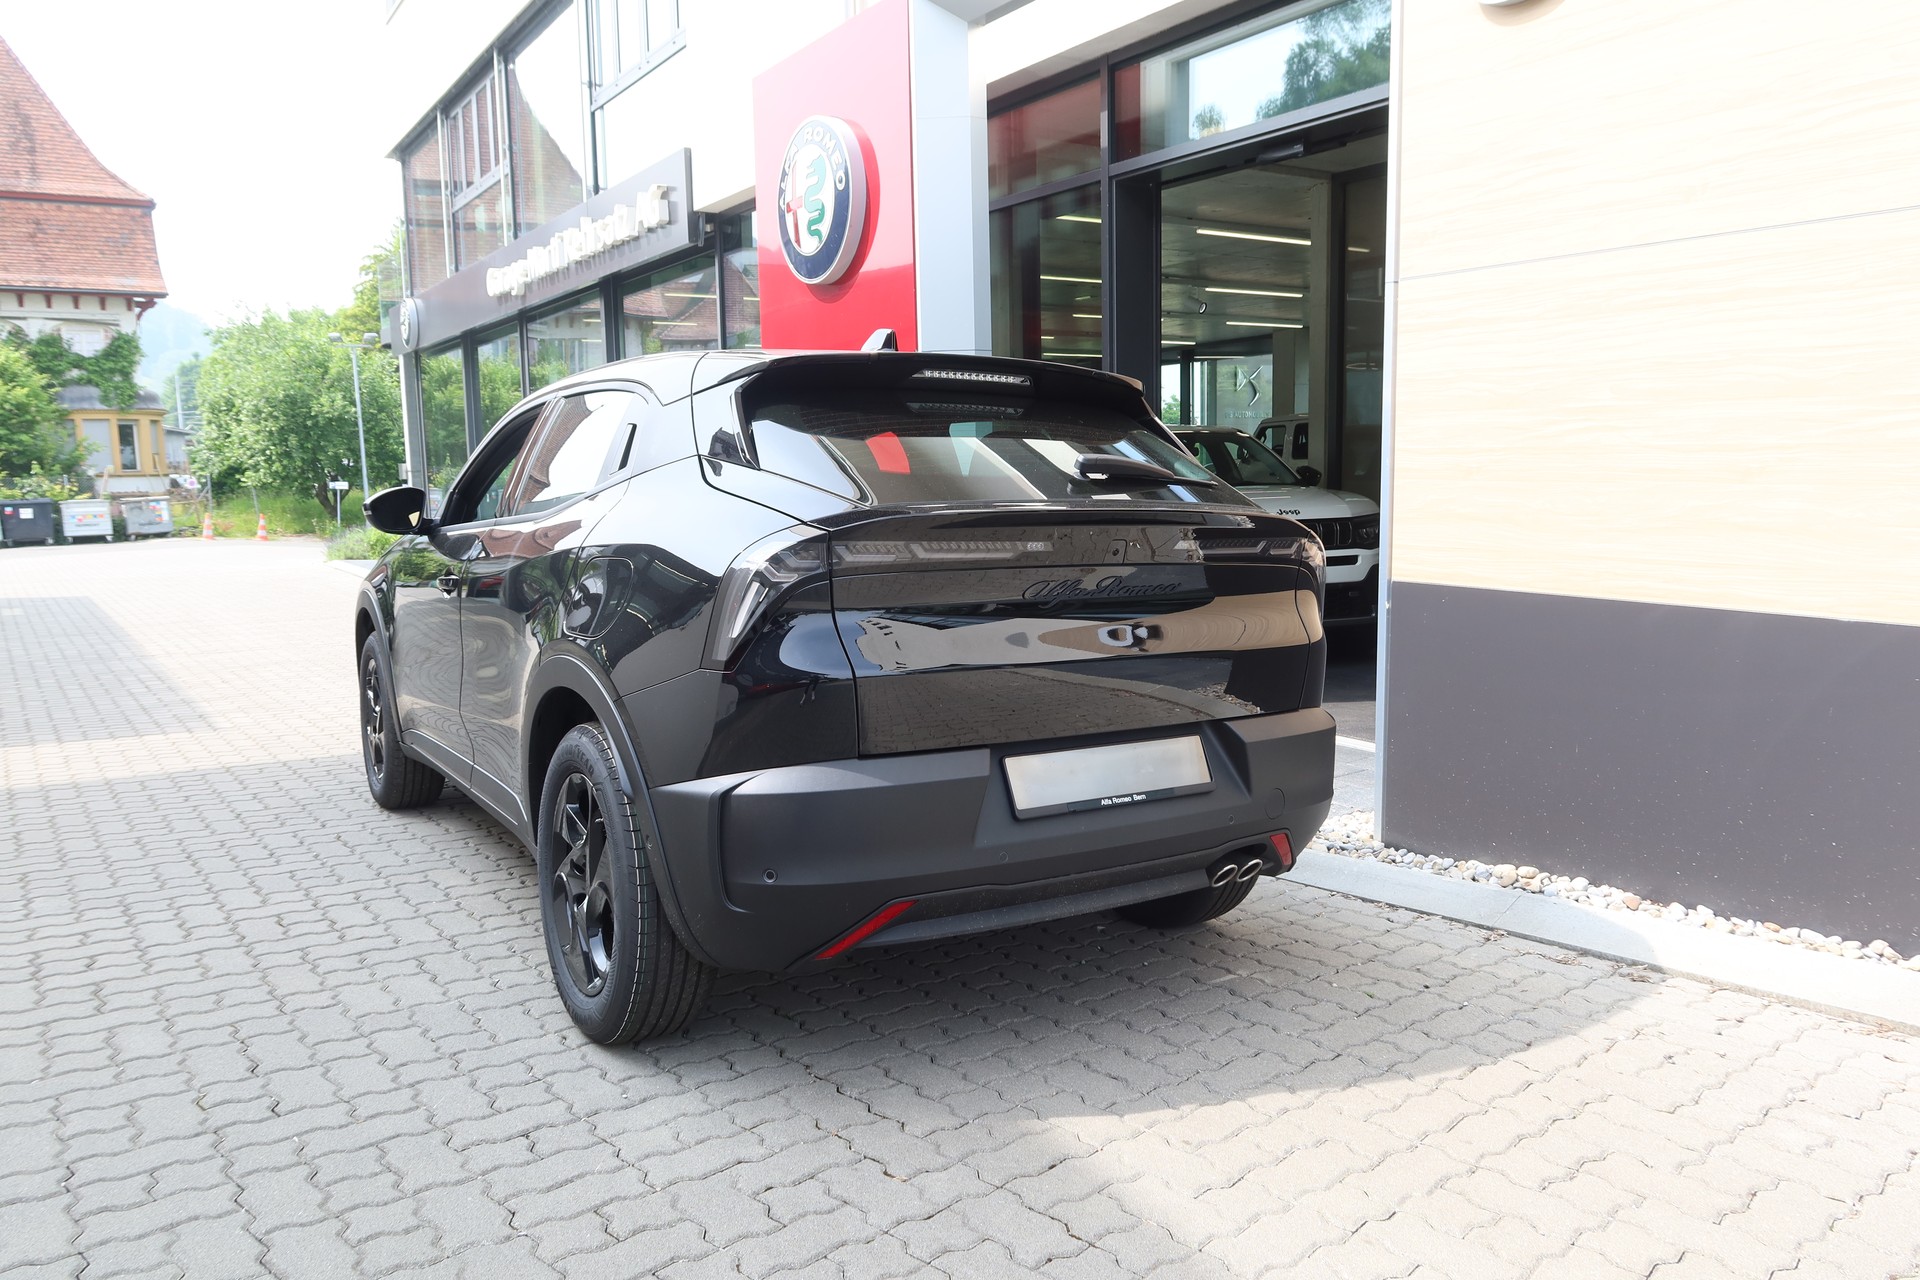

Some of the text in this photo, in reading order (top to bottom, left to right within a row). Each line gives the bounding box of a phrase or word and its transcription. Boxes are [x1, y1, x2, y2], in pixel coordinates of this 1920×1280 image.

[804, 127, 845, 190] ROMEO
[486, 258, 531, 298] Garage
[636, 184, 669, 231] AG
[1276, 508, 1301, 516] Jeep
[1022, 575, 1182, 609] Alfa Romeo
[1112, 796, 1132, 804] Romeo
